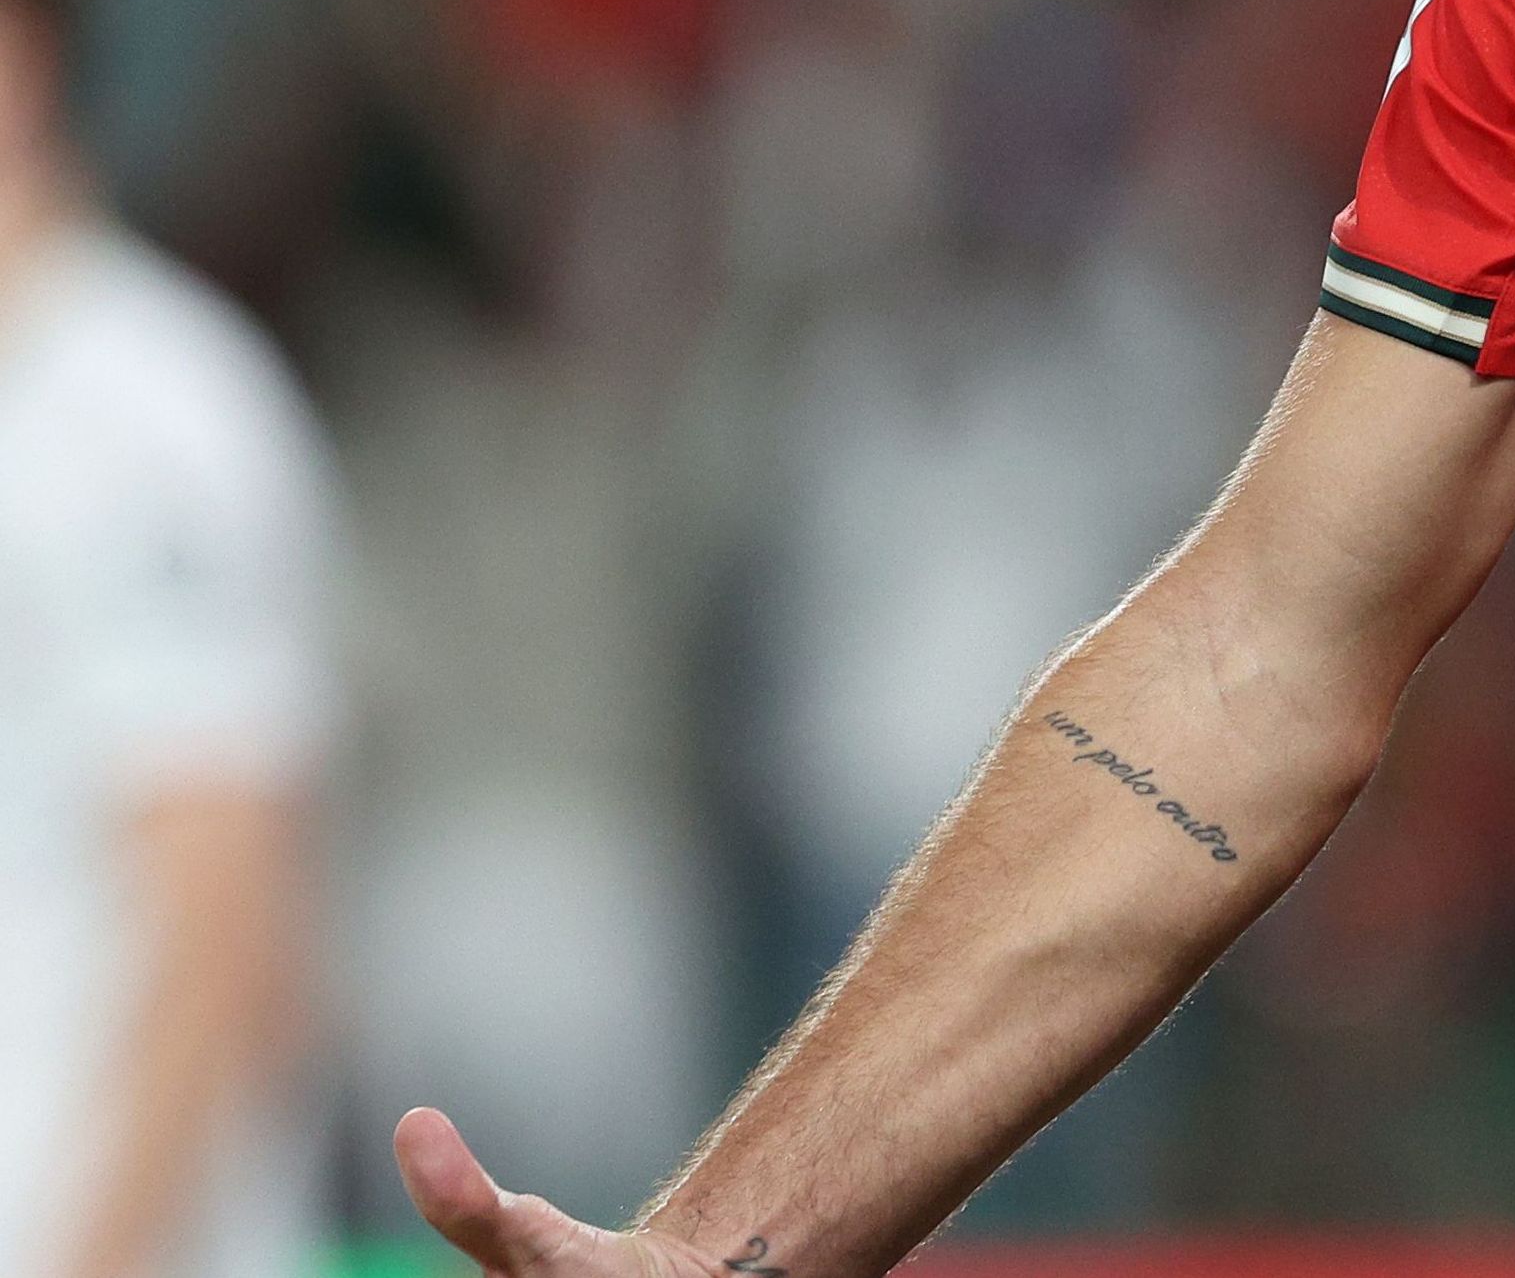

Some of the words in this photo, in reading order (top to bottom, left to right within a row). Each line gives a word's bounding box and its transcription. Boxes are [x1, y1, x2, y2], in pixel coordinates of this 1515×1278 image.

[1044, 711, 1093, 746] um
[1072, 750, 1158, 795] pelo
[1156, 801, 1237, 861] outro
